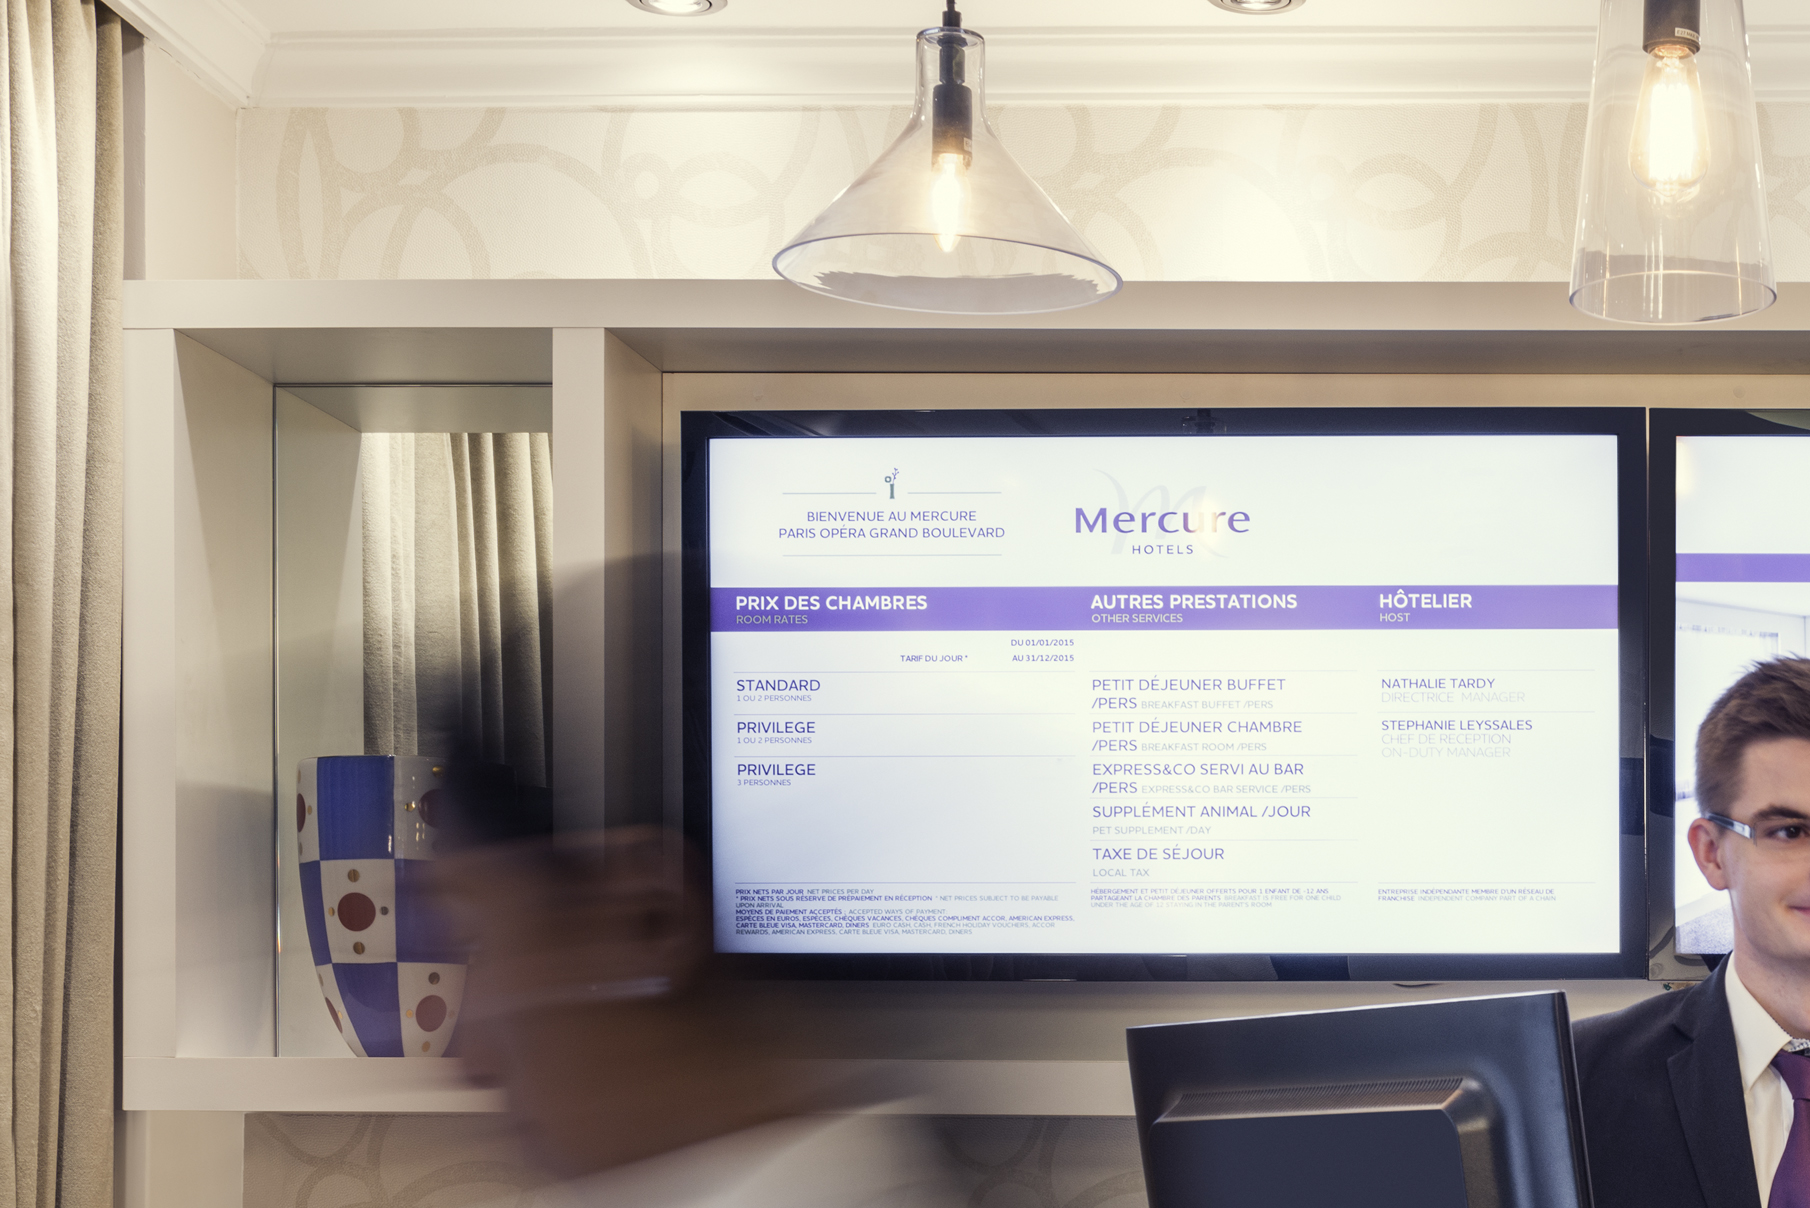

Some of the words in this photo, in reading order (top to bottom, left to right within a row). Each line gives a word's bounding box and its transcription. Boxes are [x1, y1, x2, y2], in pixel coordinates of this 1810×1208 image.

[807, 511, 884, 521] BIENVENUE
[888, 511, 906, 521] AU
[911, 511, 976, 521] MERCURE
[1075, 507, 1250, 534] Mercure
[779, 528, 816, 538] PARIS
[820, 525, 866, 538] OPÉRA
[870, 528, 918, 538] GRAND
[923, 528, 1005, 538] BOULEVARD
[1132, 545, 1193, 554] HOTELS
[736, 596, 779, 610] PRIX
[785, 596, 820, 610] DES
[826, 595, 927, 610] CHAMBRES
[1091, 594, 1163, 609] AUTRES
[1170, 594, 1297, 609] PRESTATIONS
[1380, 589, 1472, 608] HÔTELIER
[736, 615, 771, 624] ROOM
[774, 615, 808, 624] RATES
[1092, 614, 1129, 623] OTHER
[1132, 614, 1183, 623] SERVICES
[1380, 613, 1410, 622] HOST
[1011, 639, 1023, 647] DU
[1025, 639, 1074, 647] 01/01/2015
[1012, 654, 1023, 662] AU
[1025, 654, 1074, 662] 31/12/2015
[737, 680, 820, 691] STANDARD
[1093, 679, 1134, 691] PETIT
[1139, 675, 1222, 690] DÉJEUNER
[1228, 679, 1285, 690] BUFFET
[1382, 679, 1445, 688] NATHALIE
[1450, 678, 1495, 688] TARDY
[1382, 692, 1453, 702] DIRECTRICE
[1462, 692, 1525, 702] MANAGER
[1092, 697, 1137, 709] /PERS
[1142, 701, 1199, 709] BREAKFAST
[1202, 700, 1240, 709] BUFFET
[1243, 700, 1273, 708] /PERS
[737, 722, 815, 733] PRIVILEGE
[1093, 722, 1134, 733] PETIT
[1139, 718, 1222, 733] DÉJEUNER
[1227, 721, 1301, 733] CHAMBRE
[1382, 720, 1455, 730] STEPHANIE
[1460, 720, 1532, 730] LEYSSALES
[1382, 734, 1414, 744] CHEF
[1419, 734, 1435, 744] DE
[1440, 734, 1511, 744] RECEPTION
[1092, 740, 1137, 751] /PERS
[1142, 743, 1199, 751] BREAKFAST
[1202, 743, 1234, 751] ROOM
[1237, 743, 1267, 751] /PERS
[1382, 747, 1443, 758] ON-DUTY
[1447, 747, 1511, 757] MANAGER
[738, 764, 815, 775] PRIVILEGE
[1093, 764, 1195, 775] EXPRESS&CO
[1200, 763, 1243, 775] SERVI
[1249, 764, 1269, 775] AU
[1275, 763, 1303, 775] BAR
[1092, 782, 1137, 793] /PERS
[1142, 785, 1210, 793] EXPRESS&CO
[1213, 785, 1233, 793] BAR
[1236, 785, 1278, 793] SERVICE
[1281, 785, 1311, 793] /PERS
[1093, 802, 1195, 818] SUPPLÉMENT
[1200, 806, 1257, 817] ANIMAL
[1262, 806, 1310, 817] /JOUR
[1093, 826, 1112, 834] PET
[1115, 826, 1183, 834] SUPPLEMENT
[1186, 826, 1211, 834] /DAY
[1093, 848, 1131, 860] TAXE
[1137, 848, 1157, 860] DE
[1163, 844, 1224, 860] SÉJOUR
[1093, 868, 1126, 877] LOCAL
[1420, 887, 1468, 895] INDÉPENDANTE
[1518, 887, 1544, 895] RÉSEAU
